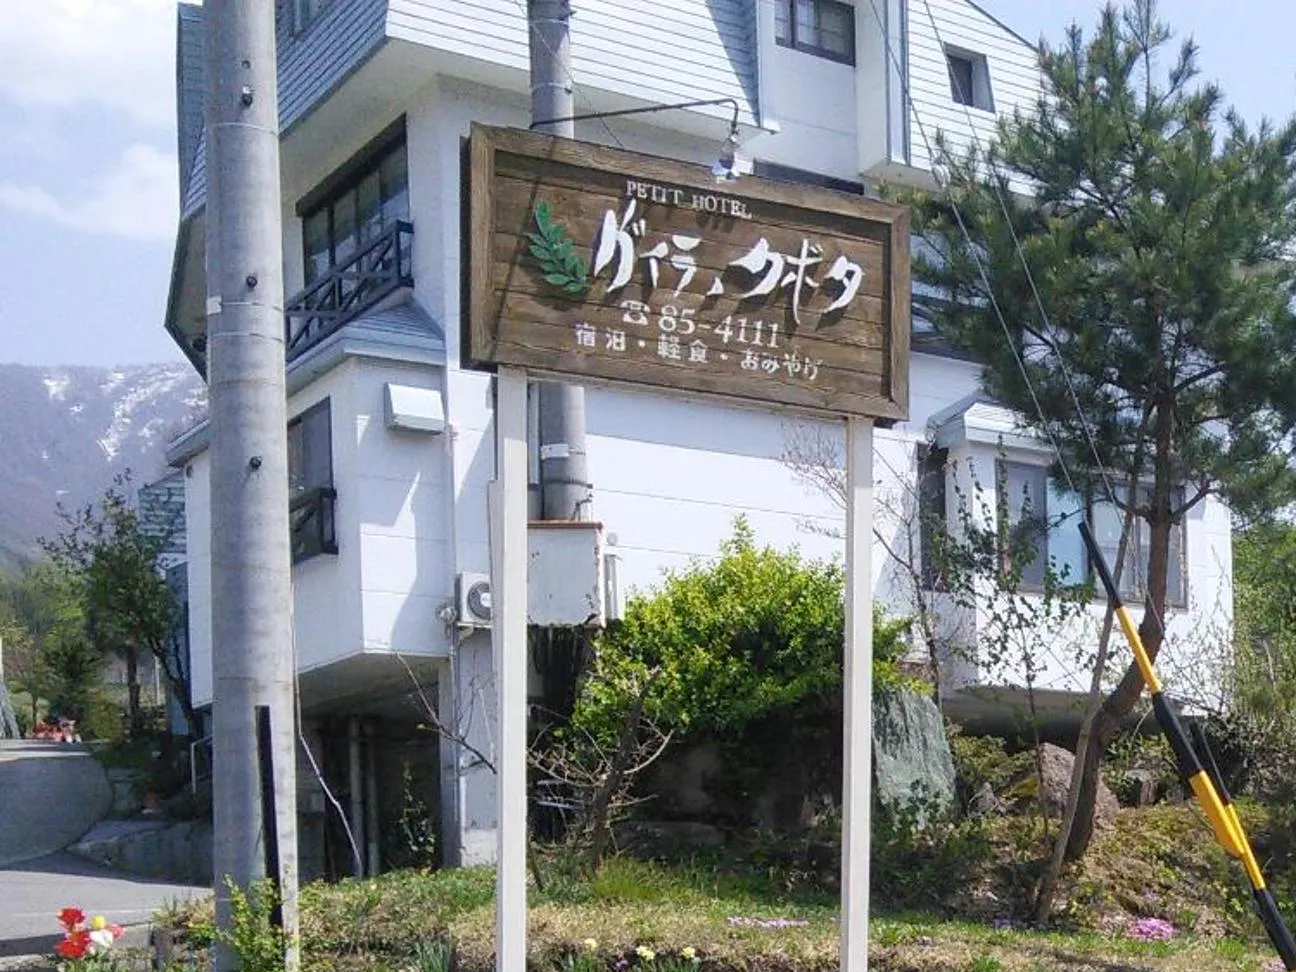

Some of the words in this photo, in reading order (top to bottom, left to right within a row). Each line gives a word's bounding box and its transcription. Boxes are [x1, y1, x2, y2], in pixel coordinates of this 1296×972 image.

[626, 180, 683, 204] PETIT
[690, 195, 752, 220] HOTEL
[657, 305, 780, 349] 85-4111
